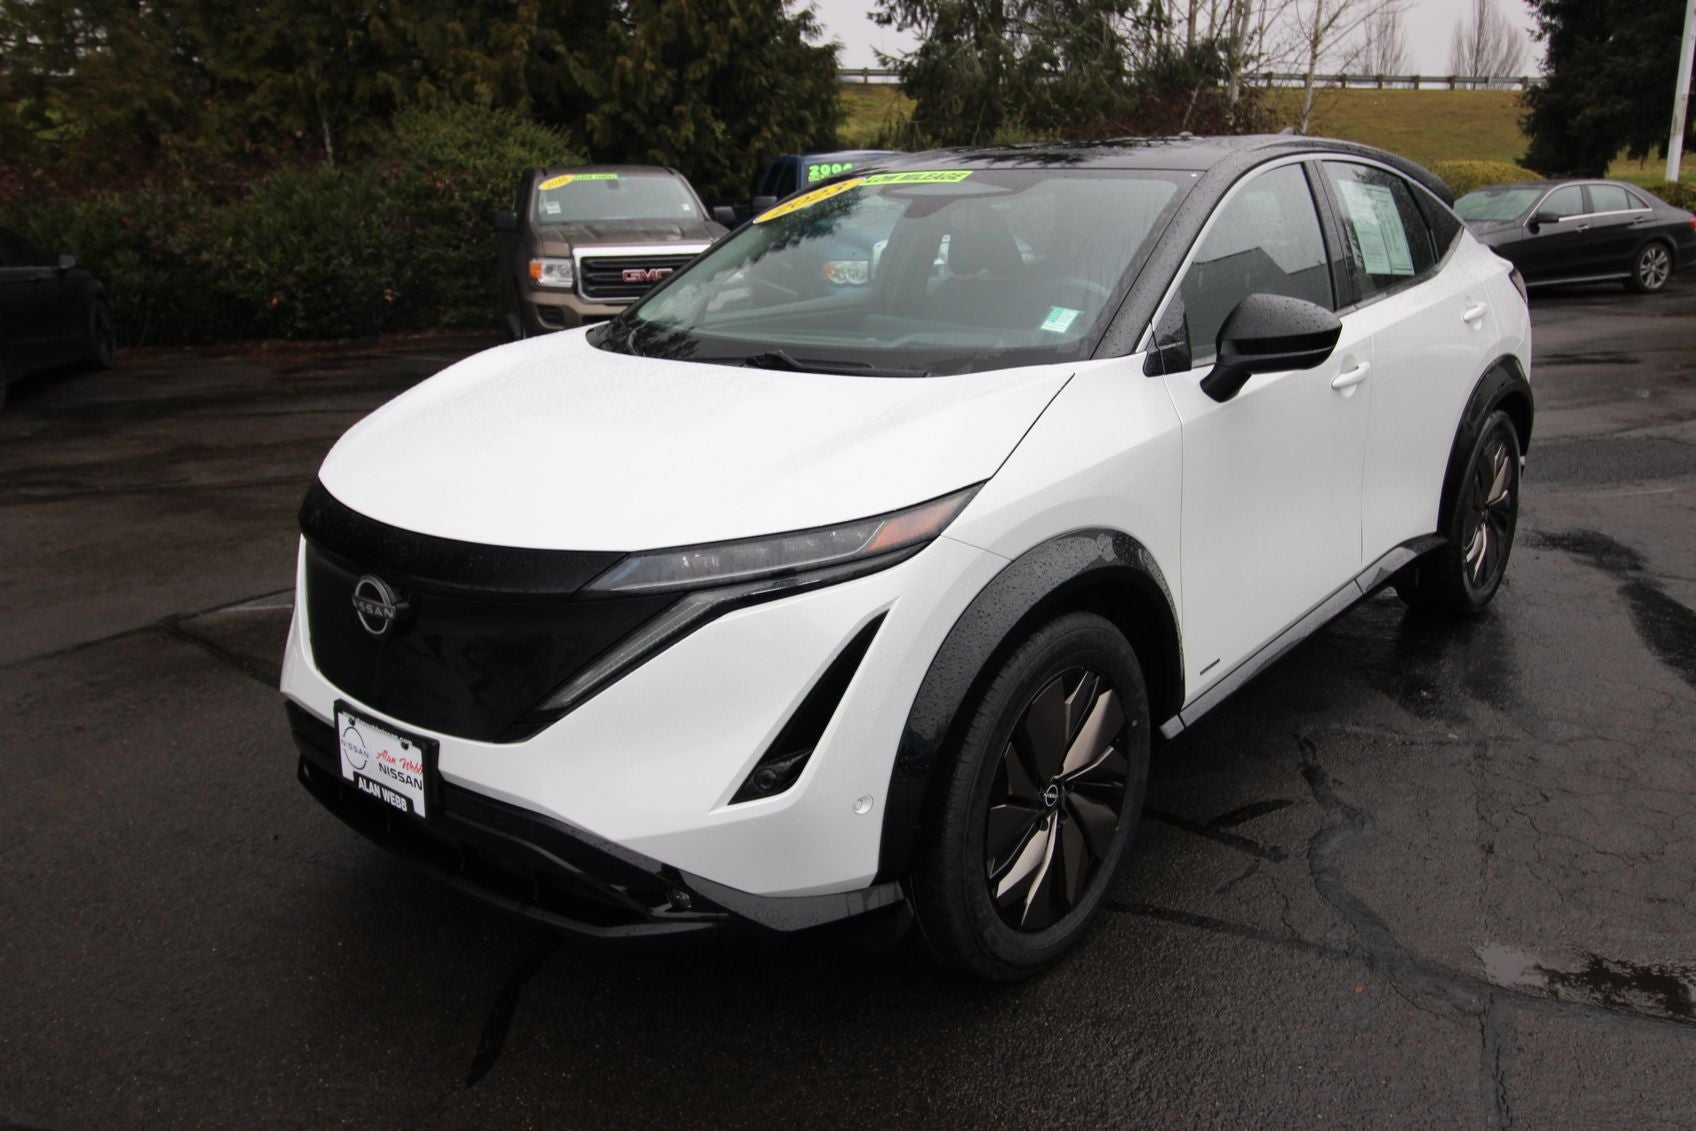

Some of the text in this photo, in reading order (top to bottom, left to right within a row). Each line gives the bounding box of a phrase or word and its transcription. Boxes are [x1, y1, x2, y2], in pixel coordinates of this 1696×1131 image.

[341, 739, 369, 758] NISSAN
[376, 749, 424, 775] Alan Webb
[378, 762, 423, 791] NISSAN
[358, 776, 408, 812] ALAN WEBB
